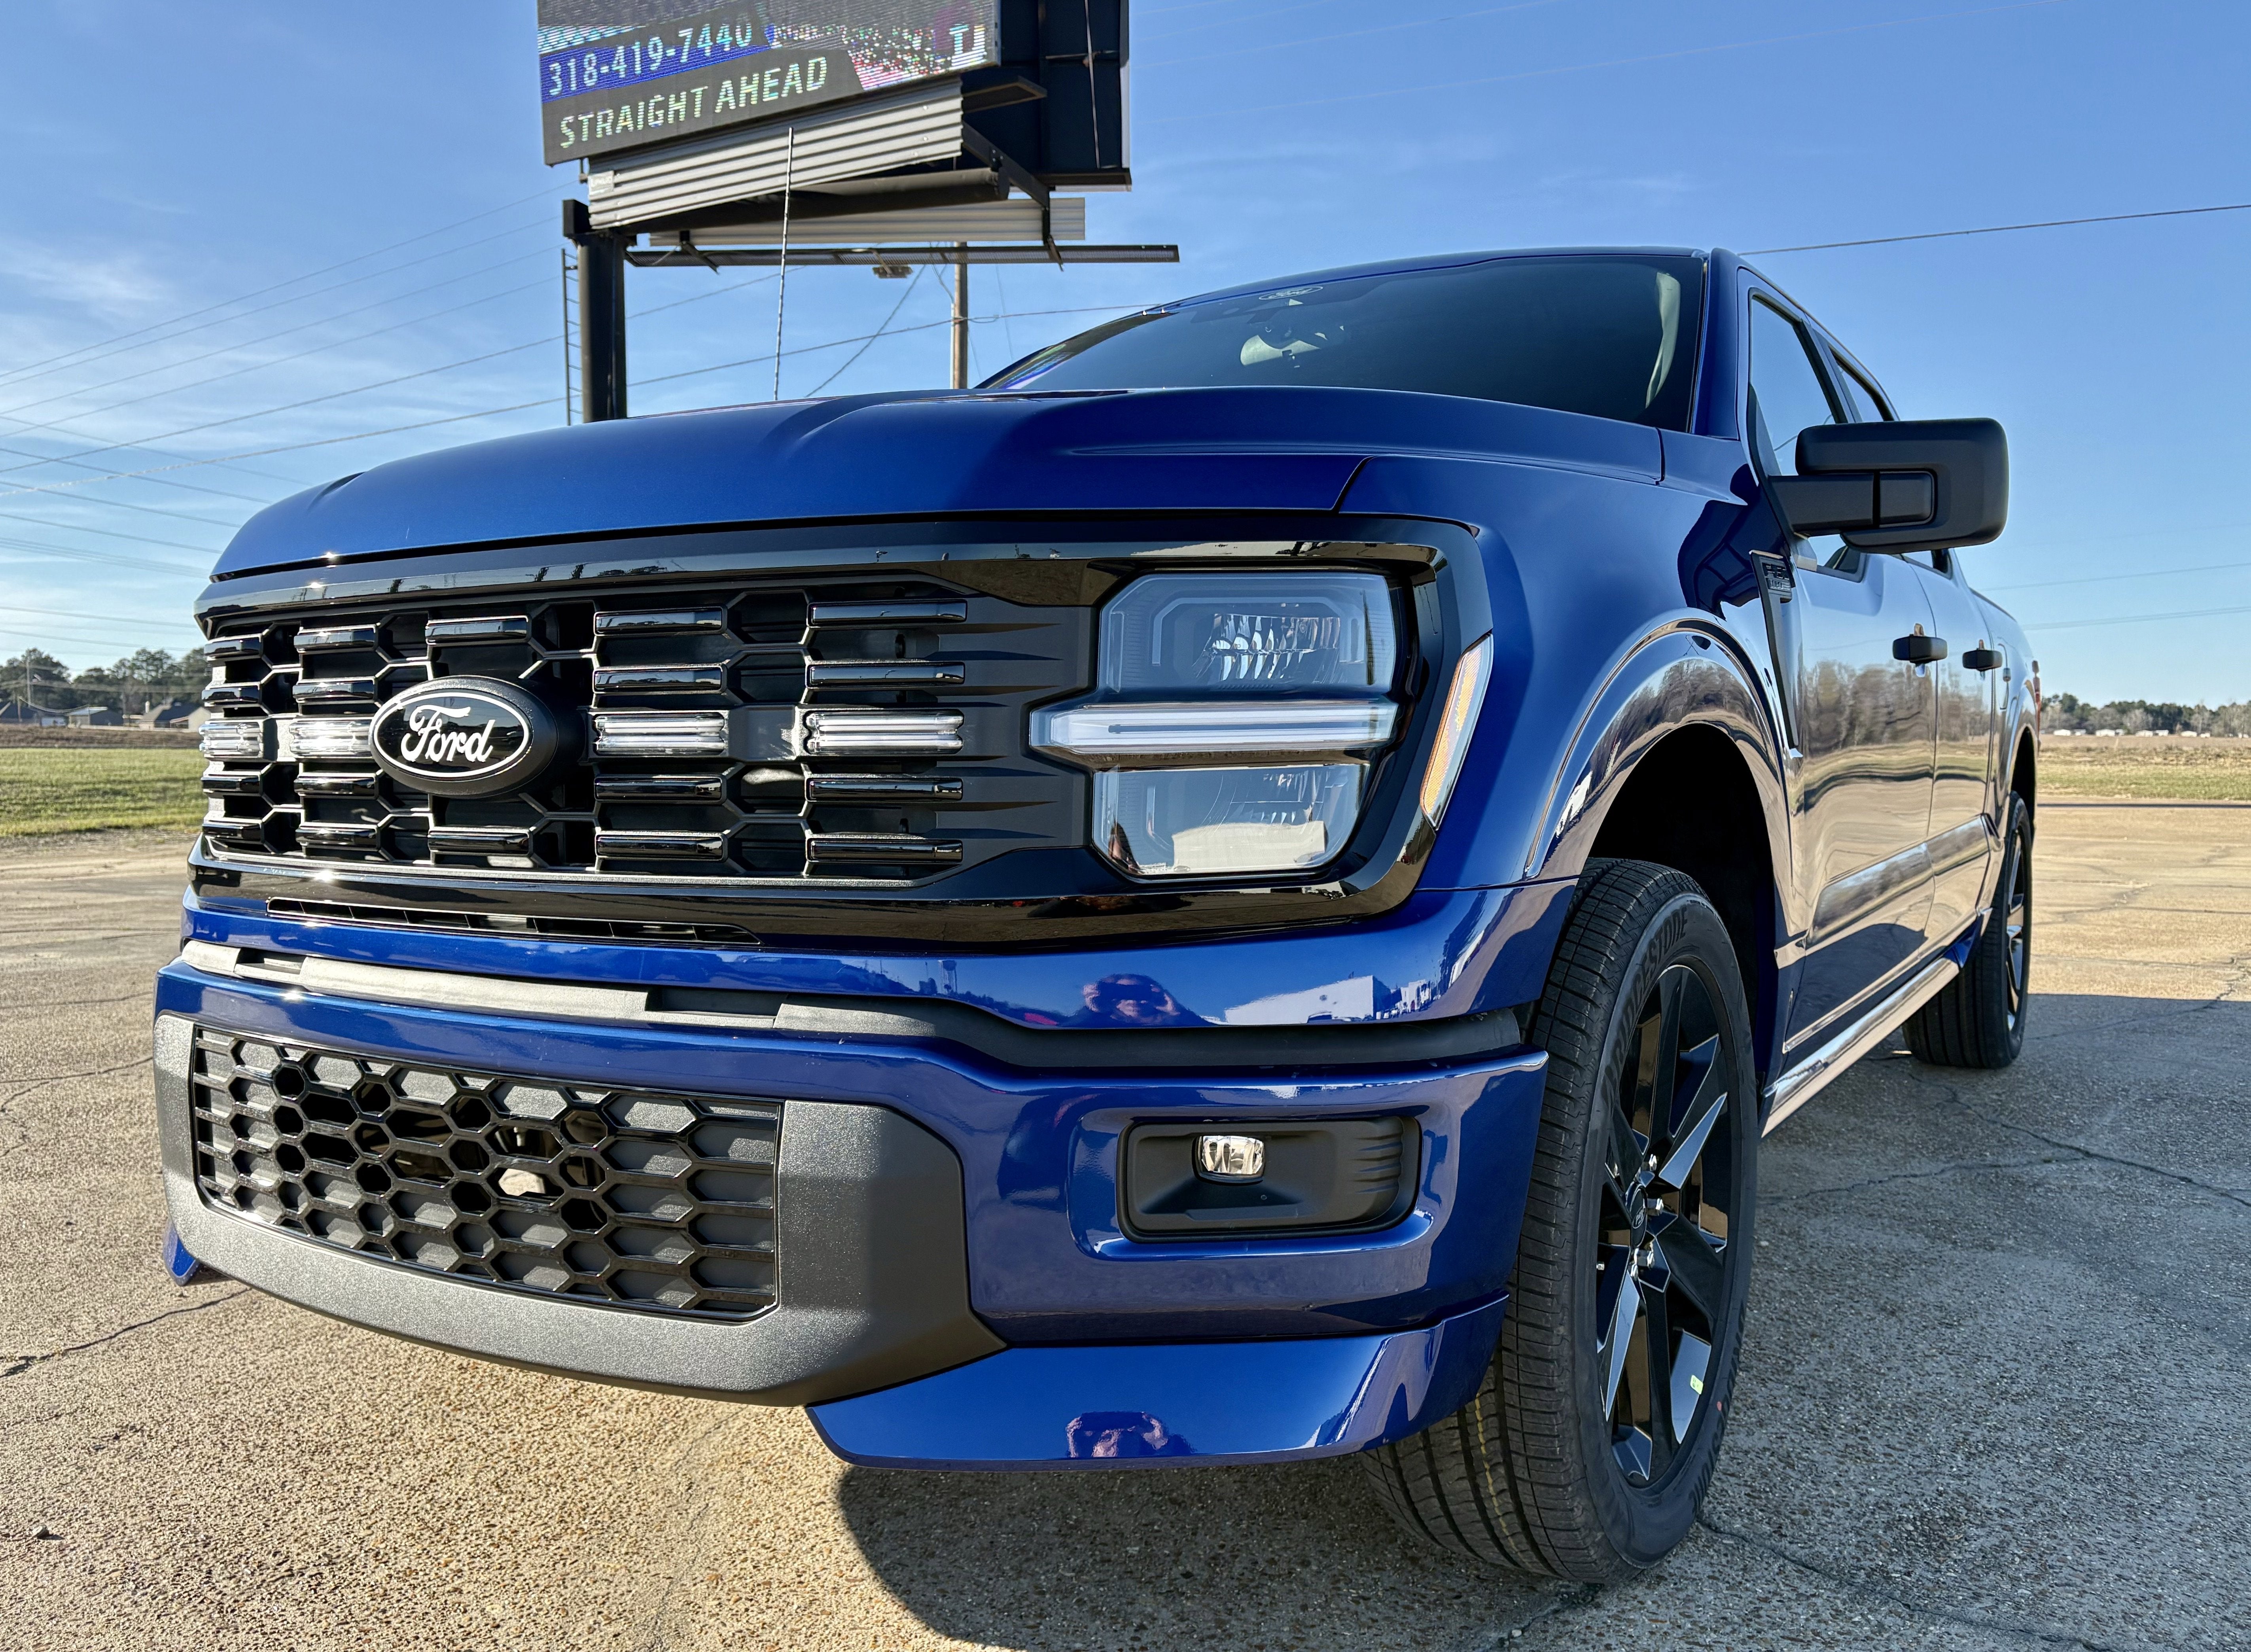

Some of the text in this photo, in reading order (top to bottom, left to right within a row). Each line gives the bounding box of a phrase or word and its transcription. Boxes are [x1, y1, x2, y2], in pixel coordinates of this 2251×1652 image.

[549, 20, 752, 96] 318-419-7440
[560, 57, 827, 148] STRAIGHT AHEAD
[401, 704, 495, 763] Ford
